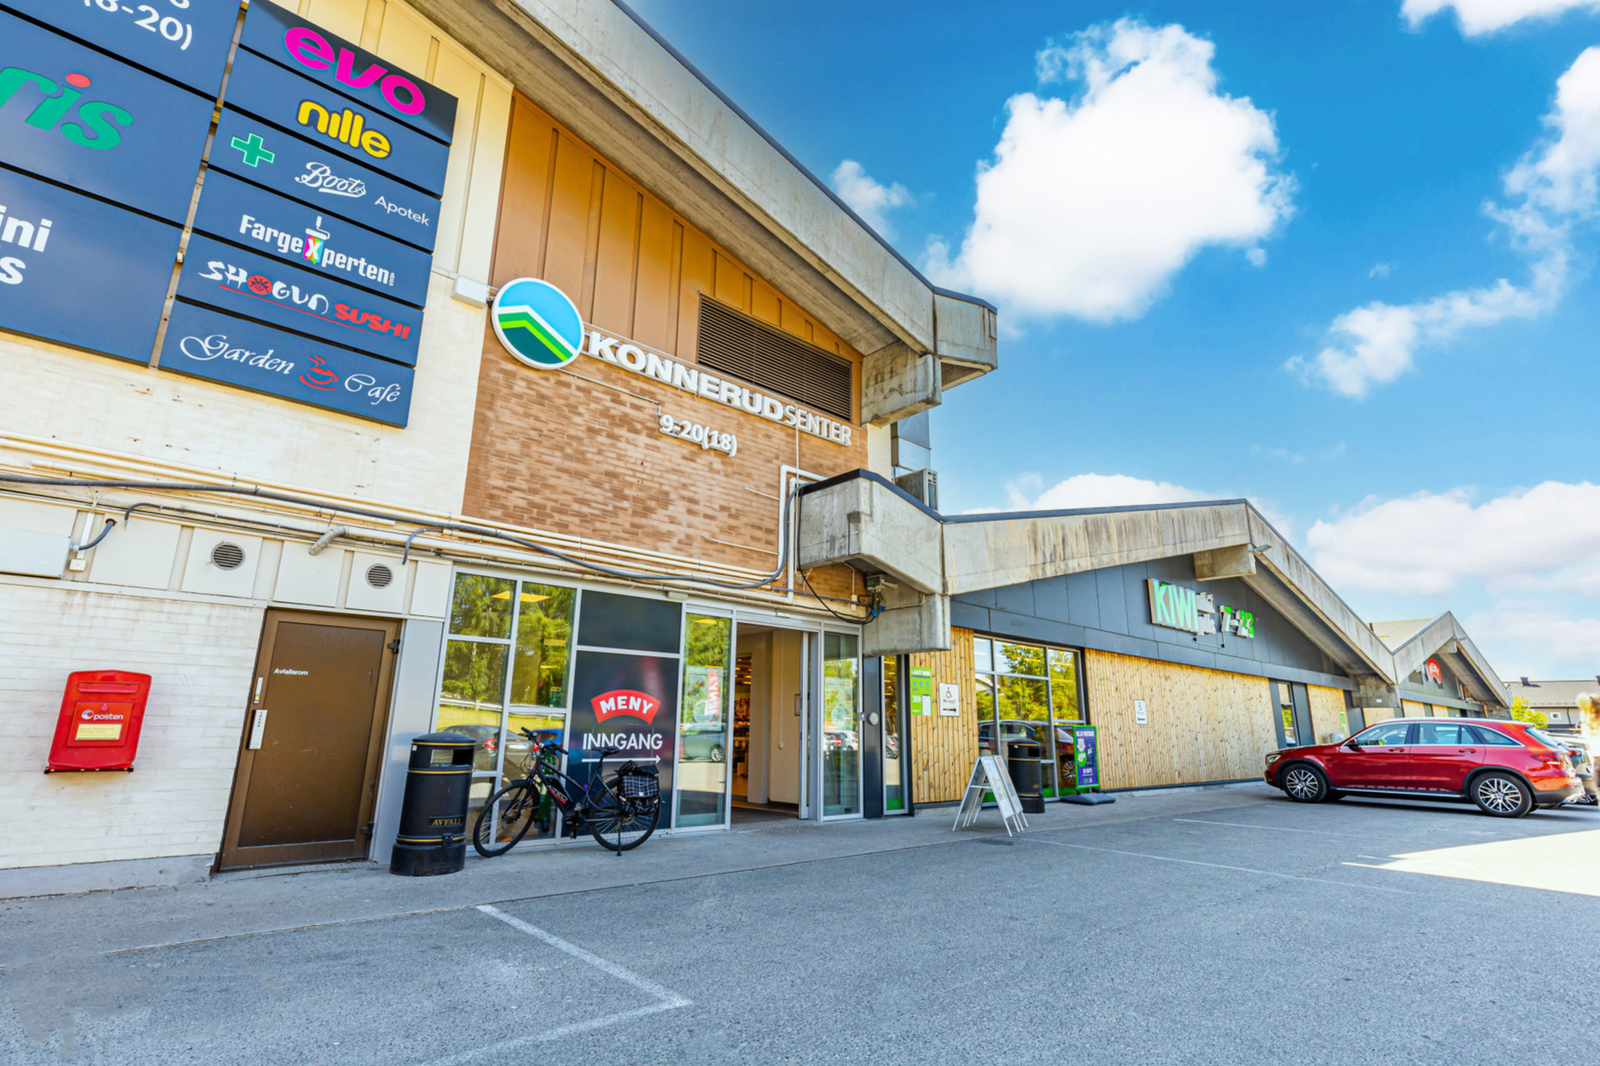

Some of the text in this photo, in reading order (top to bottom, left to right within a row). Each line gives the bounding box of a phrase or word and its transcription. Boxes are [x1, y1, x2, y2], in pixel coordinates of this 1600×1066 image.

[285, 26, 426, 115] evo
[297, 99, 391, 159] nille
[294, 161, 366, 197] Boots
[374, 196, 430, 226] Apotek
[333, 303, 411, 339] SUSHI
[180, 334, 402, 405] Garden Café
[1148, 578, 1199, 633] KIWI
[599, 695, 654, 714] MENY
[582, 732, 663, 750] INNGANG
